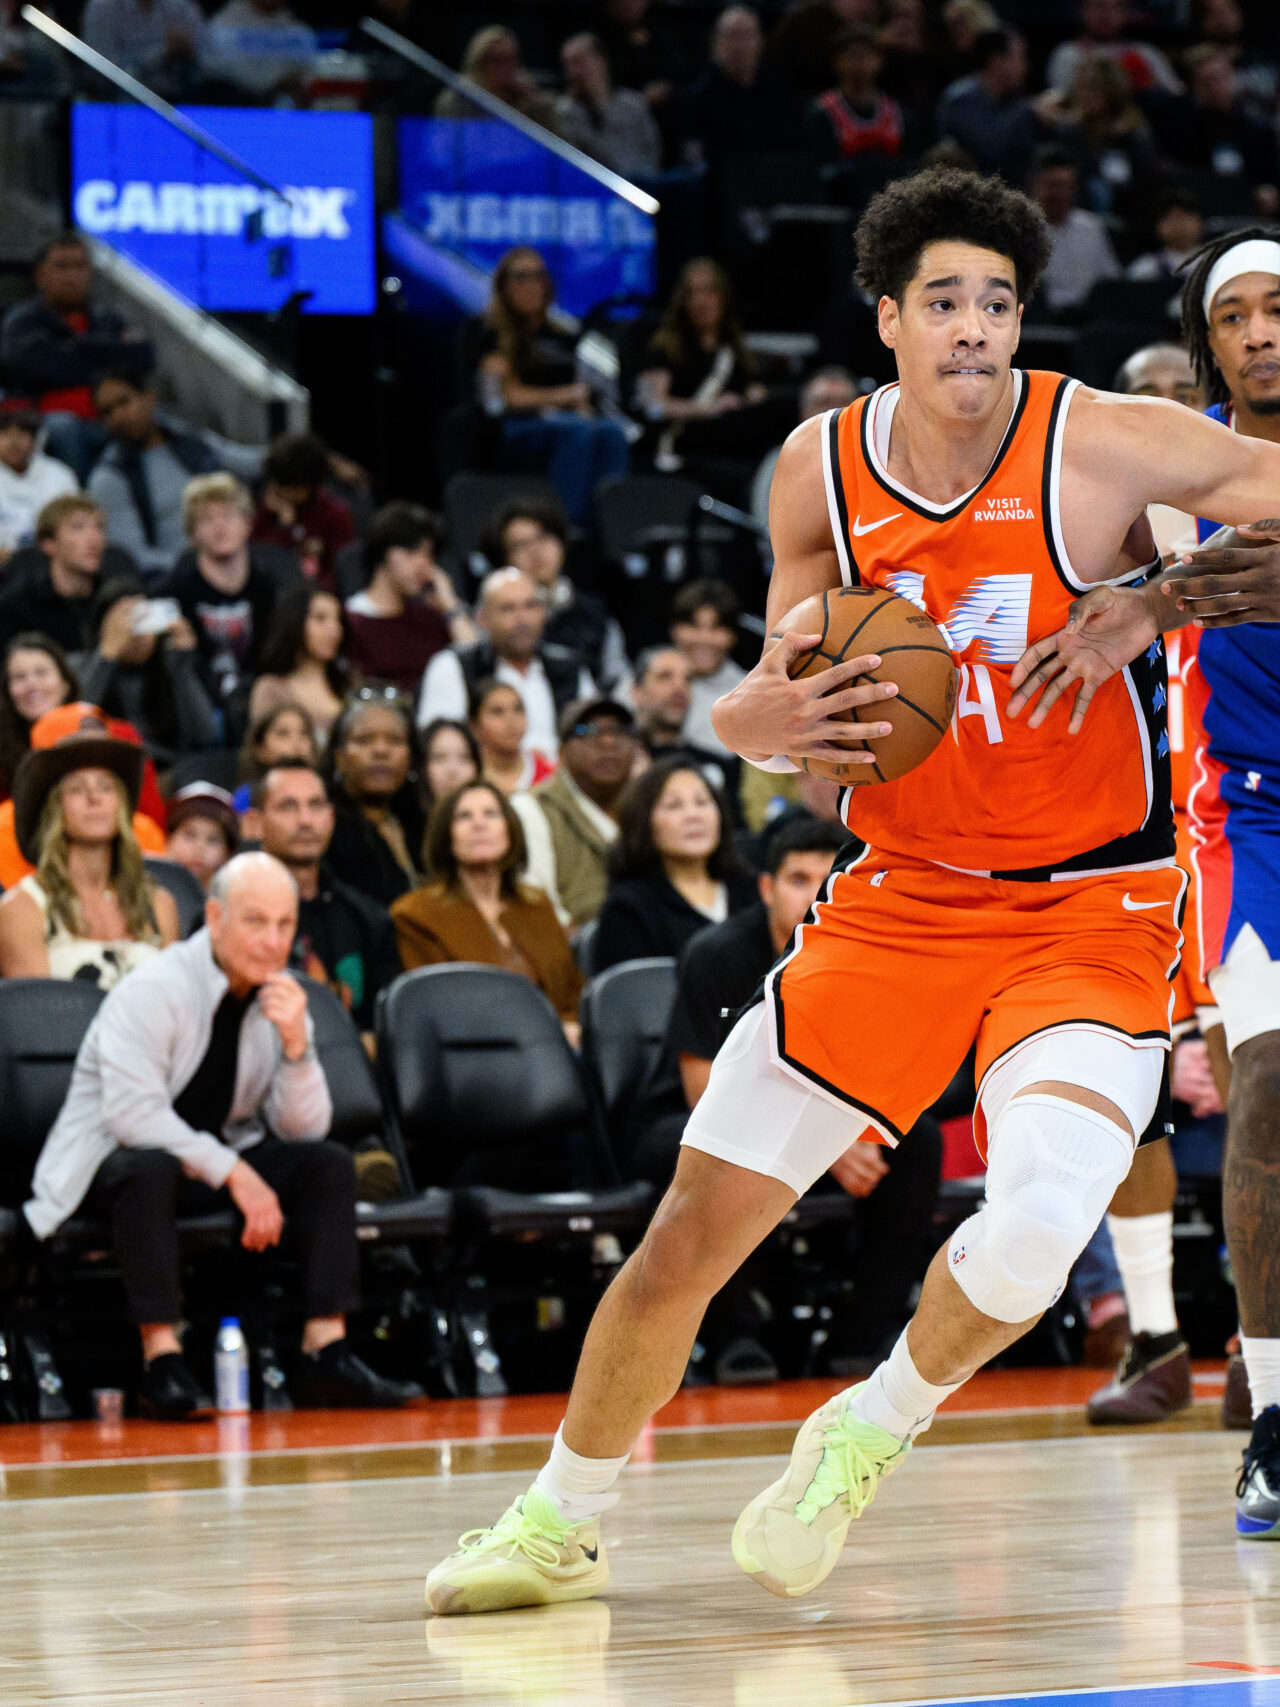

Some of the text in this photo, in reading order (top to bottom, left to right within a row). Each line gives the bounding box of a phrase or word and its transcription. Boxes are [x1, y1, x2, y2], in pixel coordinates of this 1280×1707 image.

[987, 498, 1021, 509] VISIT
[974, 508, 1035, 522] RWANDA
[950, 662, 1004, 748] 4
